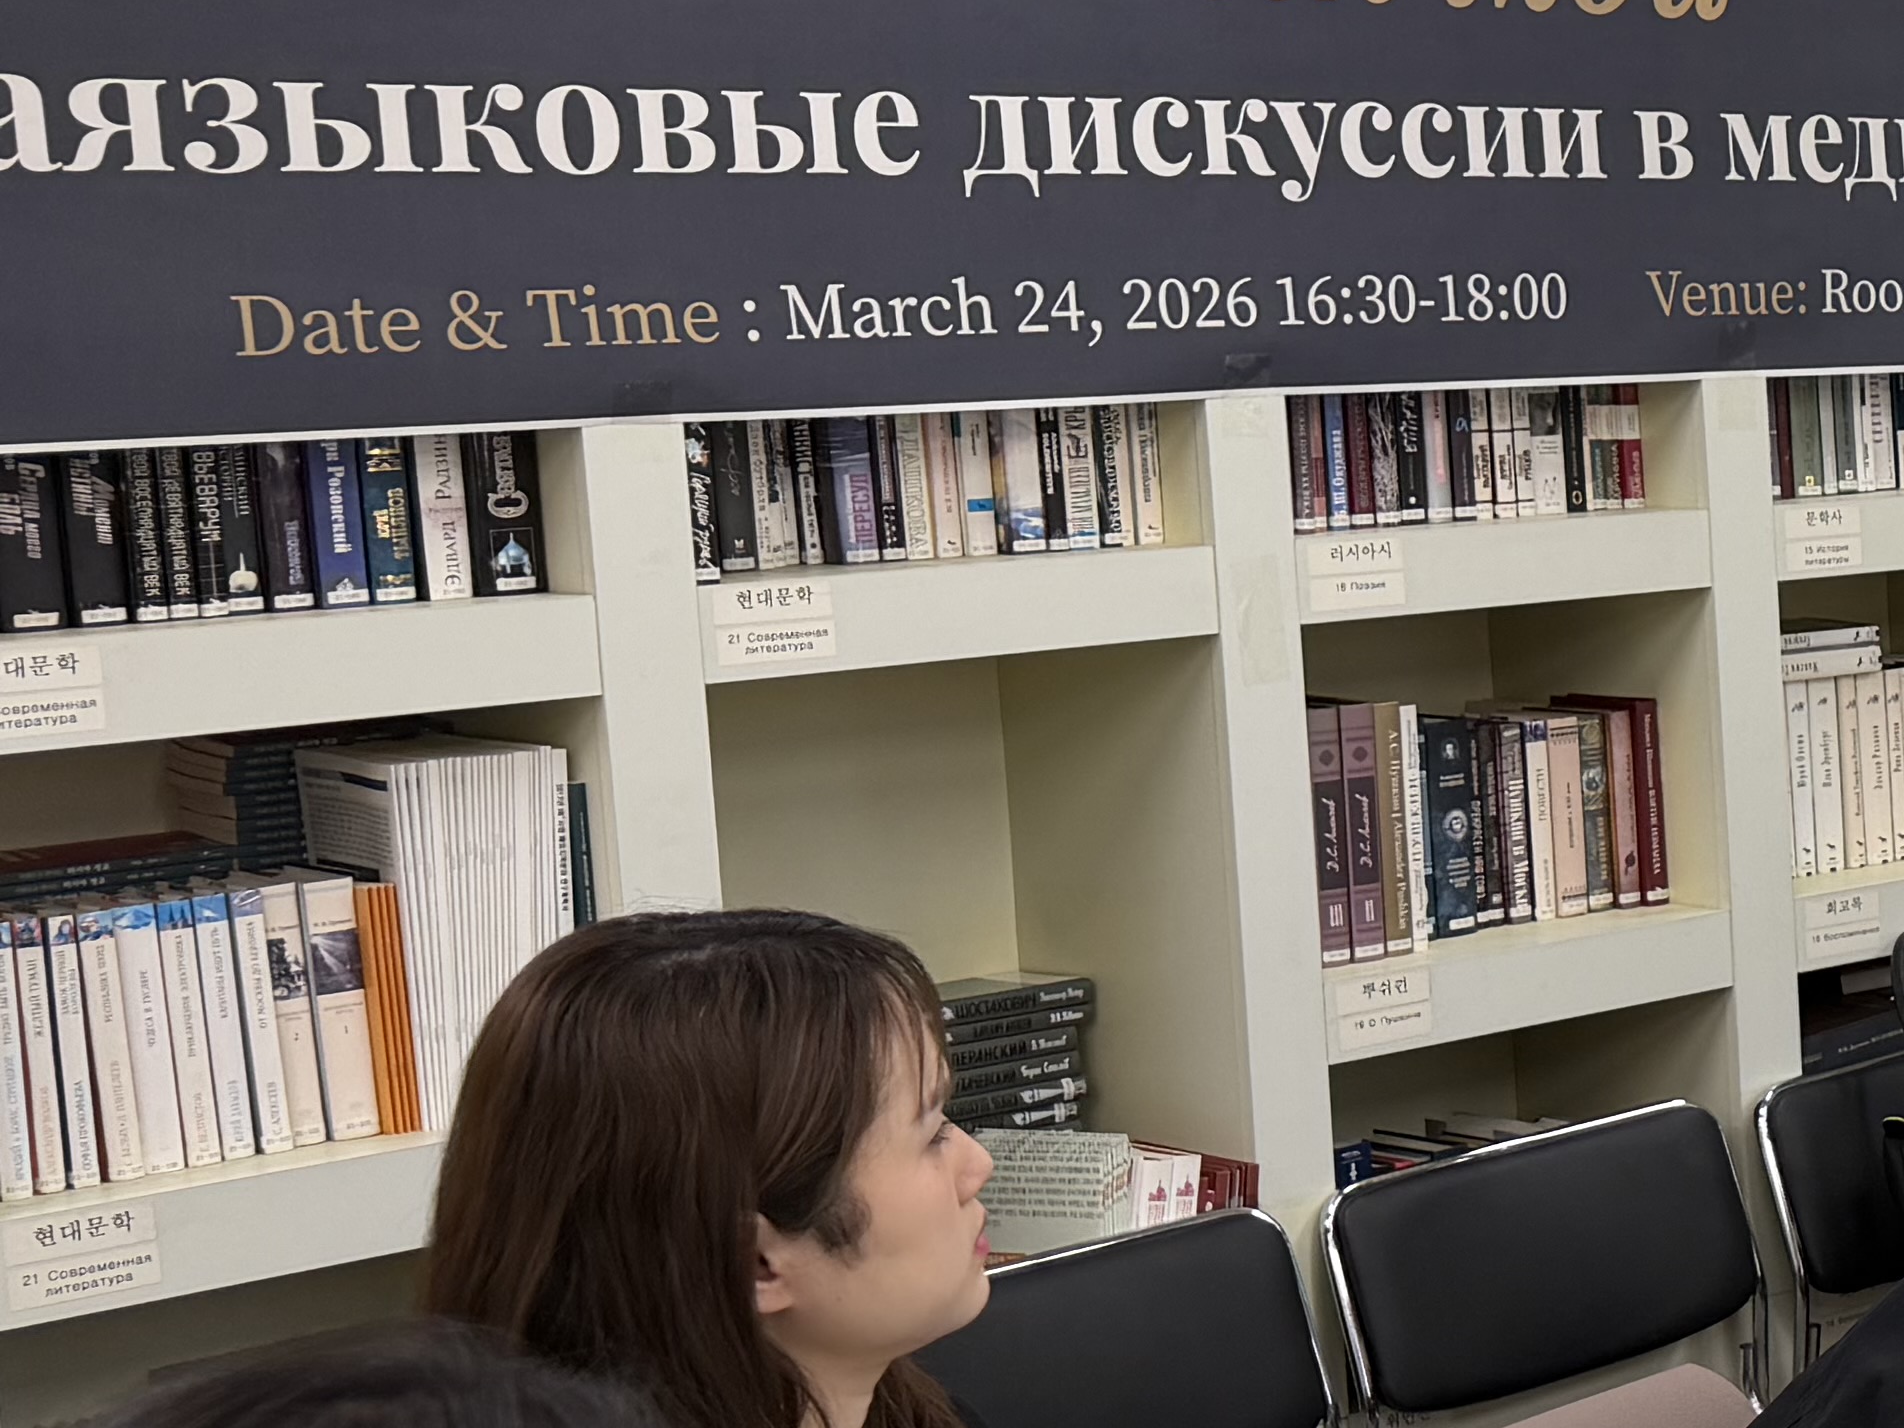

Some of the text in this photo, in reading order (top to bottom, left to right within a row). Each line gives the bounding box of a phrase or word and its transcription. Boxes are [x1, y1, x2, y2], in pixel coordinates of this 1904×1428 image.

[962, 92, 1604, 202] дискуссии
[1638, 111, 1695, 184] в
[234, 289, 423, 360] Date
[445, 291, 508, 351] &
[525, 284, 721, 348] Time
[780, 276, 998, 344] March
[1014, 276, 1105, 348] 24,
[1124, 274, 1258, 332] 2026
[1276, 270, 1568, 328] 16:30-18:00
[1646, 268, 1808, 316] Venue:
[1804, 509, 1843, 528] 문학사
[1330, 541, 1393, 563] 러시아시
[735, 584, 815, 612] 현대문학
[727, 632, 741, 645] 21
[33, 1208, 136, 1248] 현대문학
[22, 1252, 153, 1289] 21 Современная
[44, 1270, 135, 1298] литература
